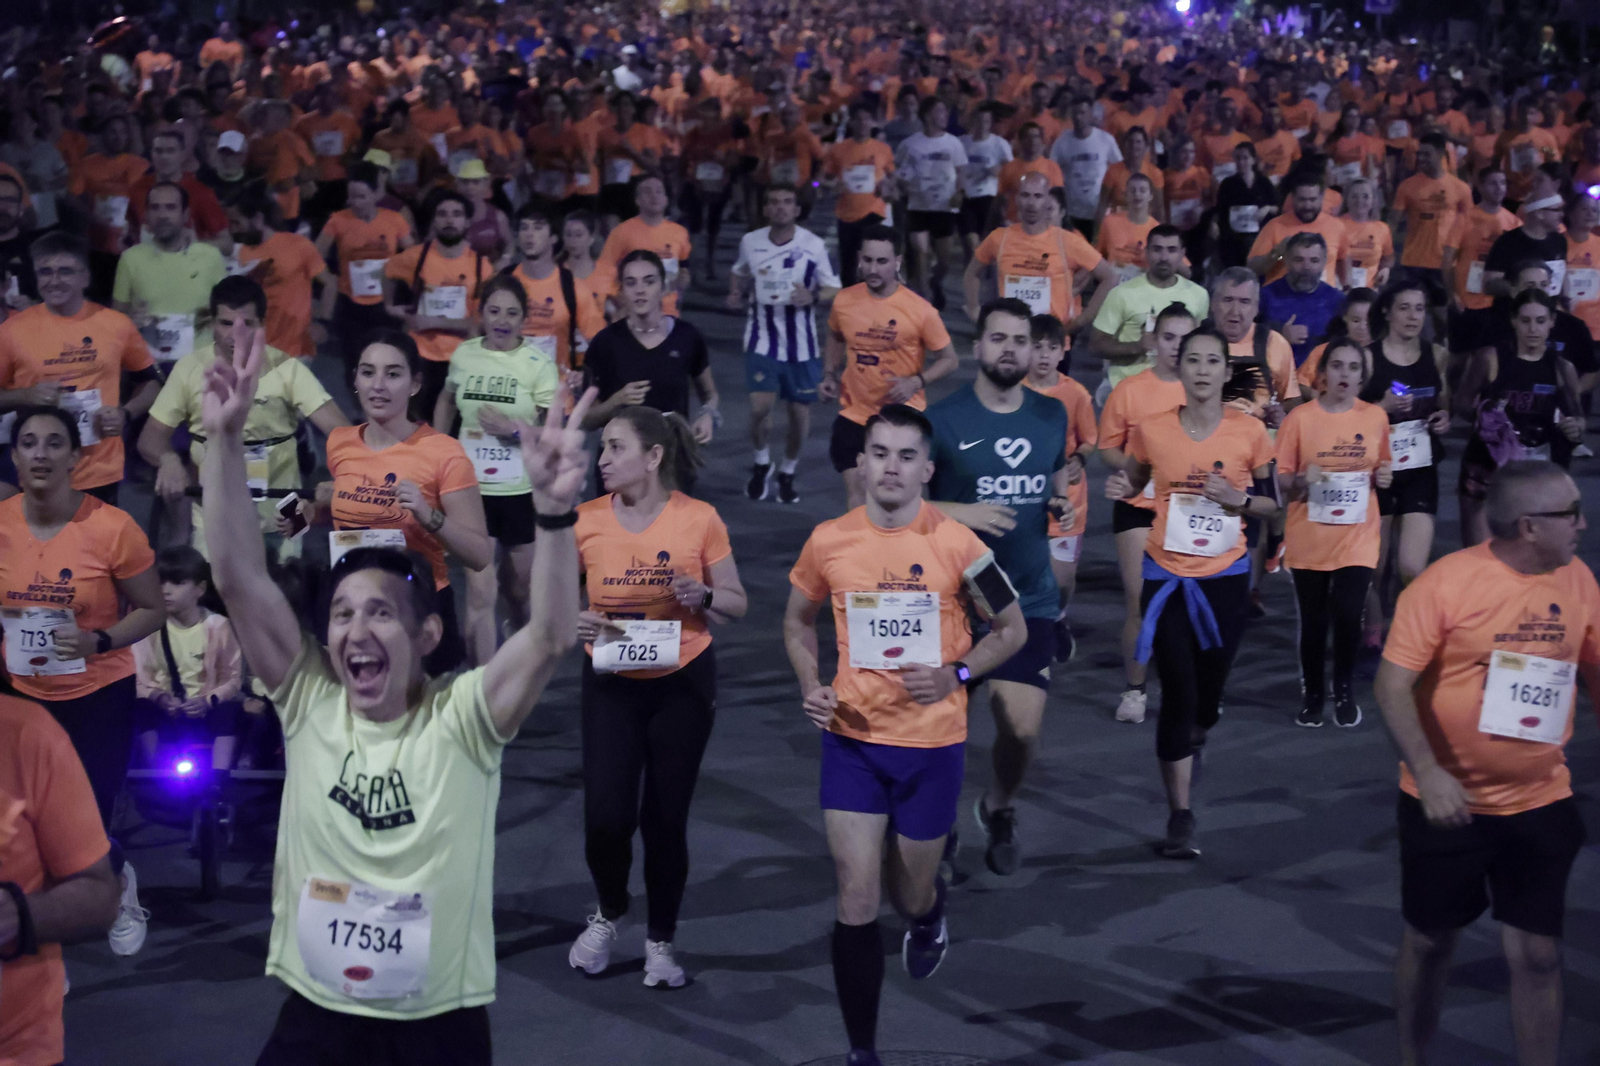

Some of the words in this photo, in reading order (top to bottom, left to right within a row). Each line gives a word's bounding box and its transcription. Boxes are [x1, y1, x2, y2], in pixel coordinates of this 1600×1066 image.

[1014, 289, 1041, 300] 11529
[475, 447, 511, 461] 17532
[976, 474, 1046, 496] sano
[337, 490, 372, 504] SEVILLA
[1188, 514, 1223, 533] 6720
[624, 568, 675, 577] NOCTURNA
[602, 575, 648, 586] SEVILLA
[647, 576, 673, 587] KH7
[877, 582, 928, 592] NOCTURNA
[27, 584, 76, 594] NOCTURNA
[6, 591, 47, 602] SEVILLA
[868, 619, 923, 637] 15024
[618, 644, 658, 661] 7625
[1510, 682, 1561, 709] 16281
[328, 918, 403, 955] 17534
